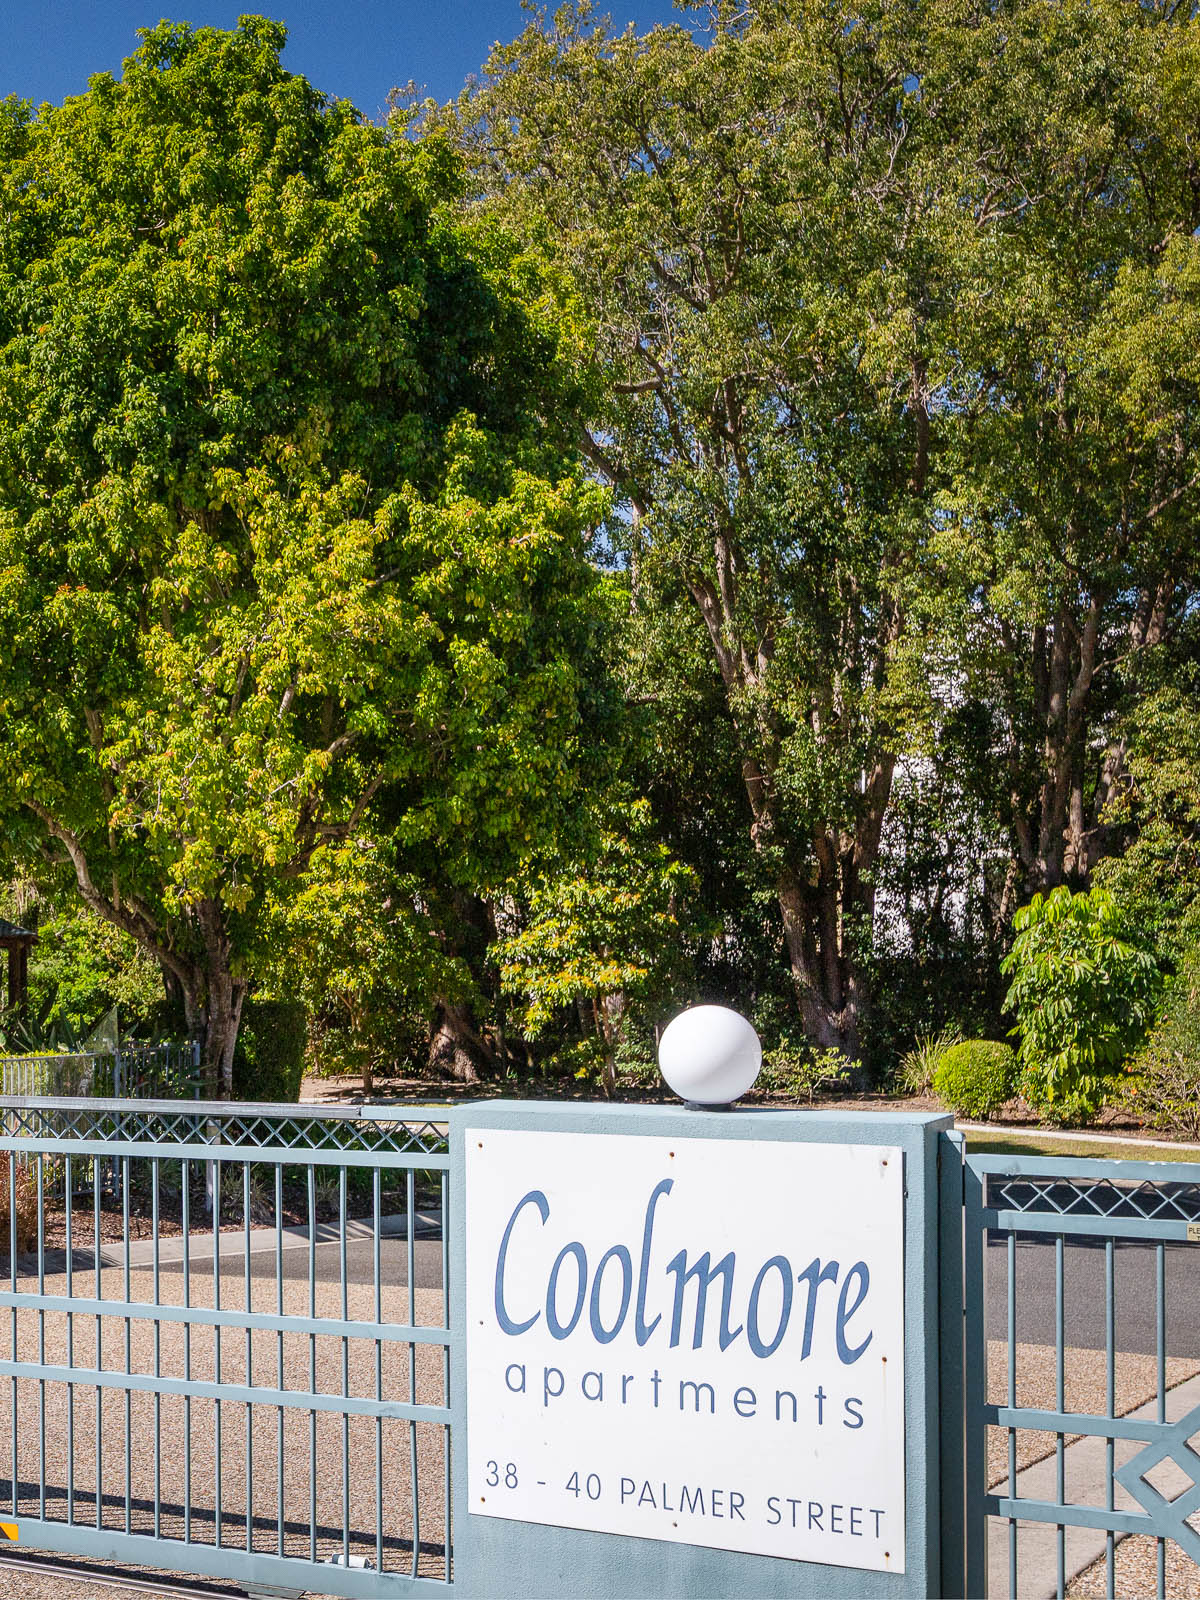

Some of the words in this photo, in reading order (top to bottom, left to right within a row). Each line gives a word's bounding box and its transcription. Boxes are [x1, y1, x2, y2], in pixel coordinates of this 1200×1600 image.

[494, 1178, 874, 1366] Coolmore
[504, 1362, 866, 1430] apartments
[485, 1460, 519, 1490] 38
[565, 1471, 602, 1501] 40
[620, 1477, 746, 1521] PALMER
[766, 1496, 887, 1539] STREET
